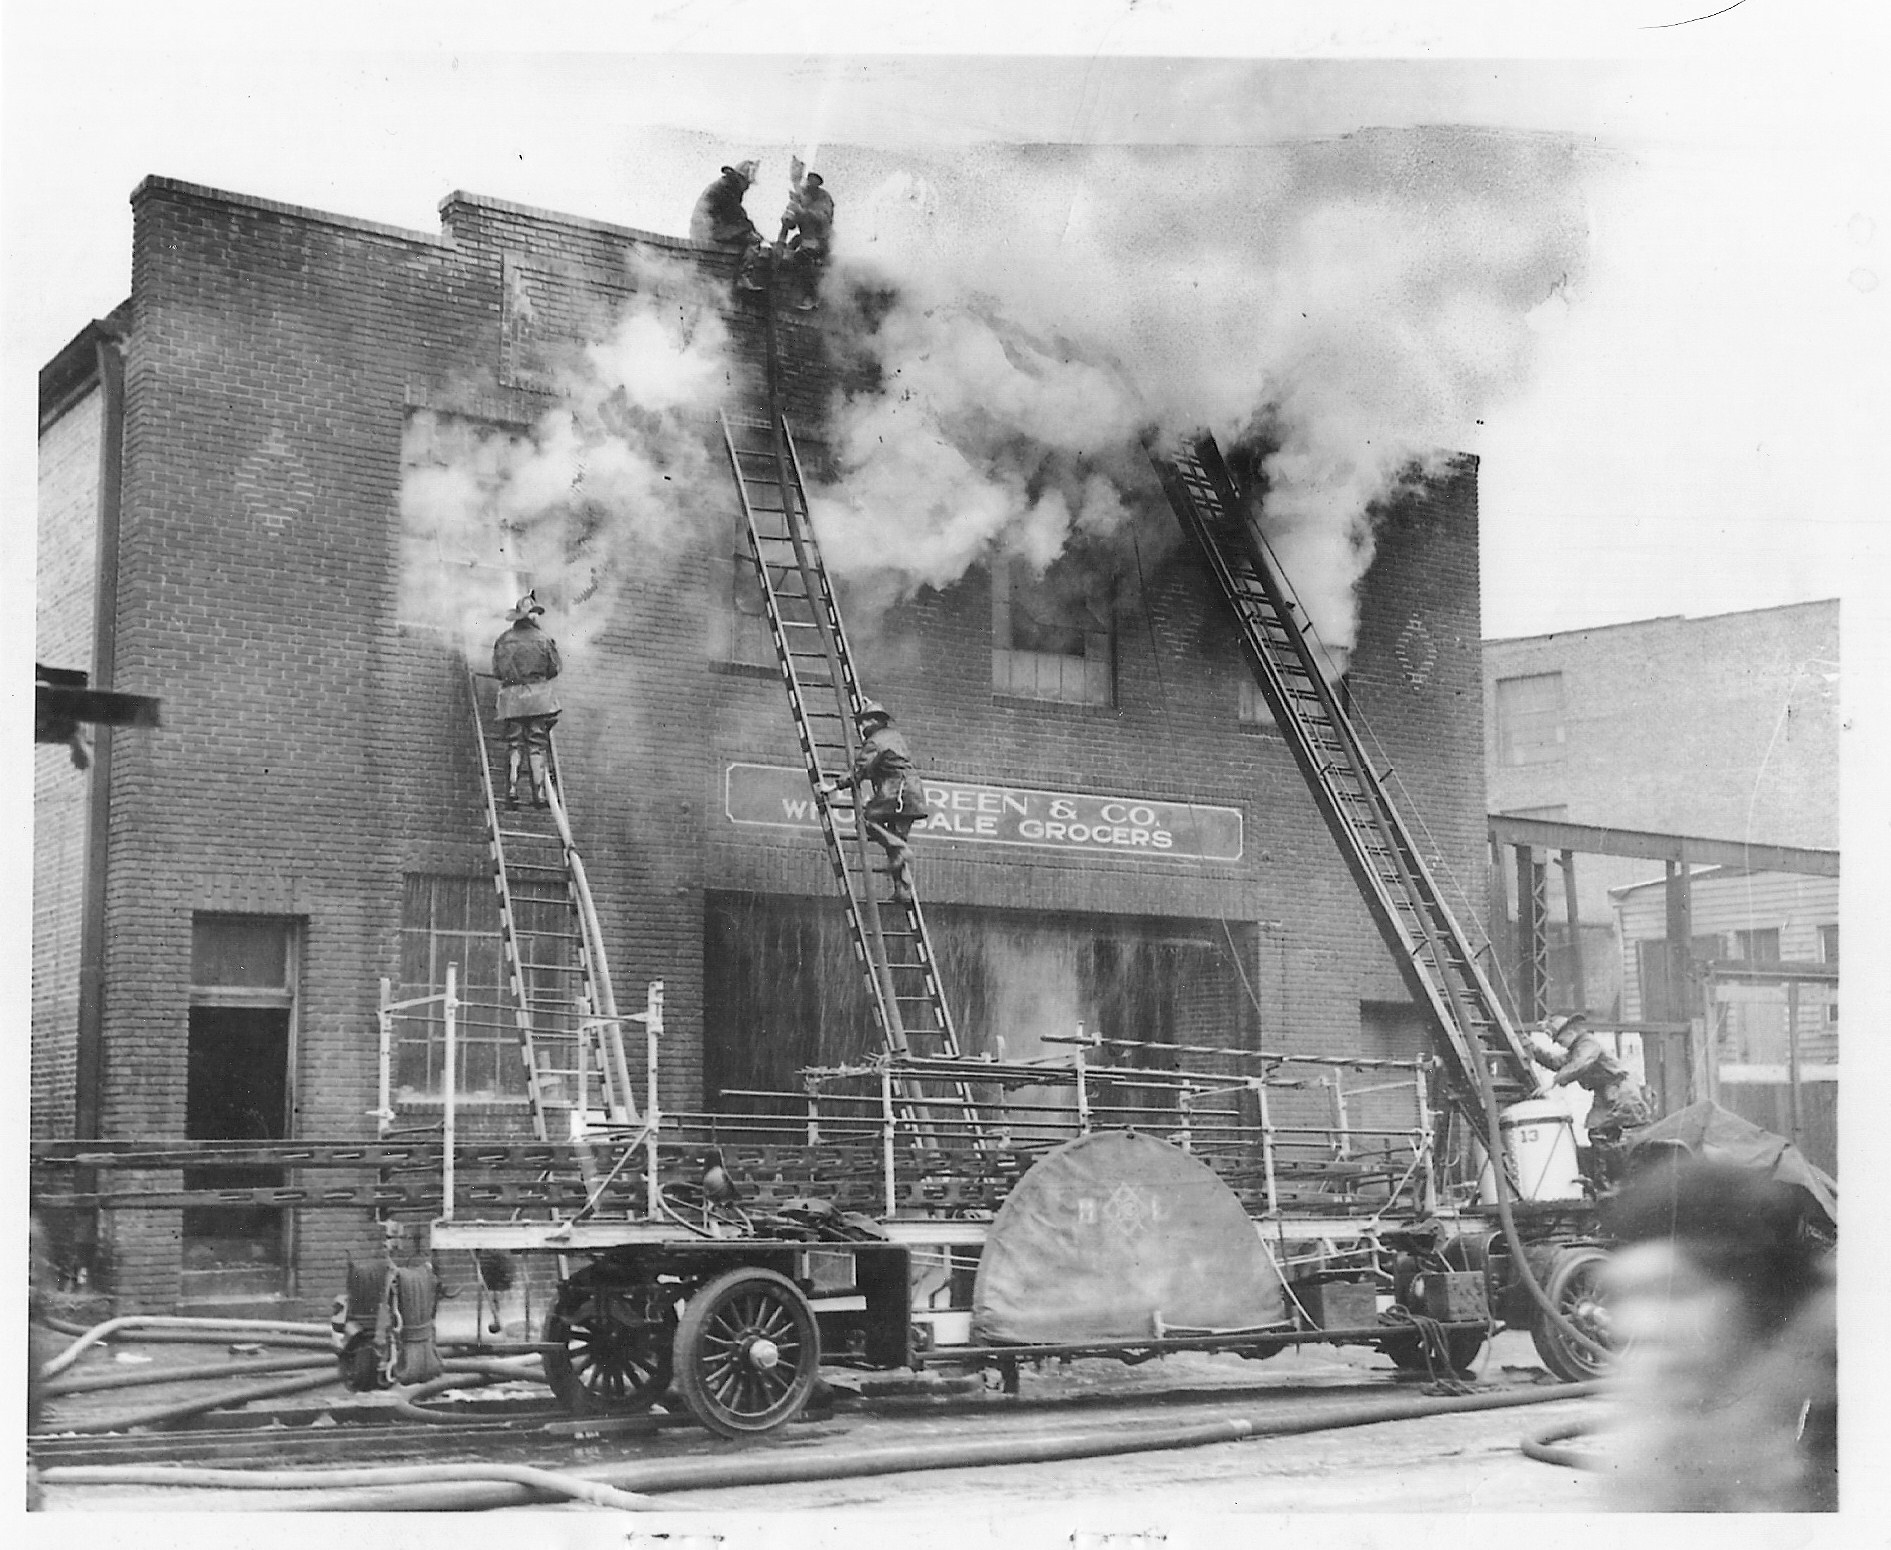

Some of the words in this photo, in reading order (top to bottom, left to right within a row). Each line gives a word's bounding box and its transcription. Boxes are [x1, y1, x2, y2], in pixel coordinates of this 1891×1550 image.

[782, 799, 998, 835] WOSALE
[1019, 819, 1173, 848] GROCERS
[922, 787, 1028, 816] REEN
[1049, 800, 1077, 820] &
[1101, 804, 1161, 828] CO.
[1520, 1129, 1539, 1143] 13
